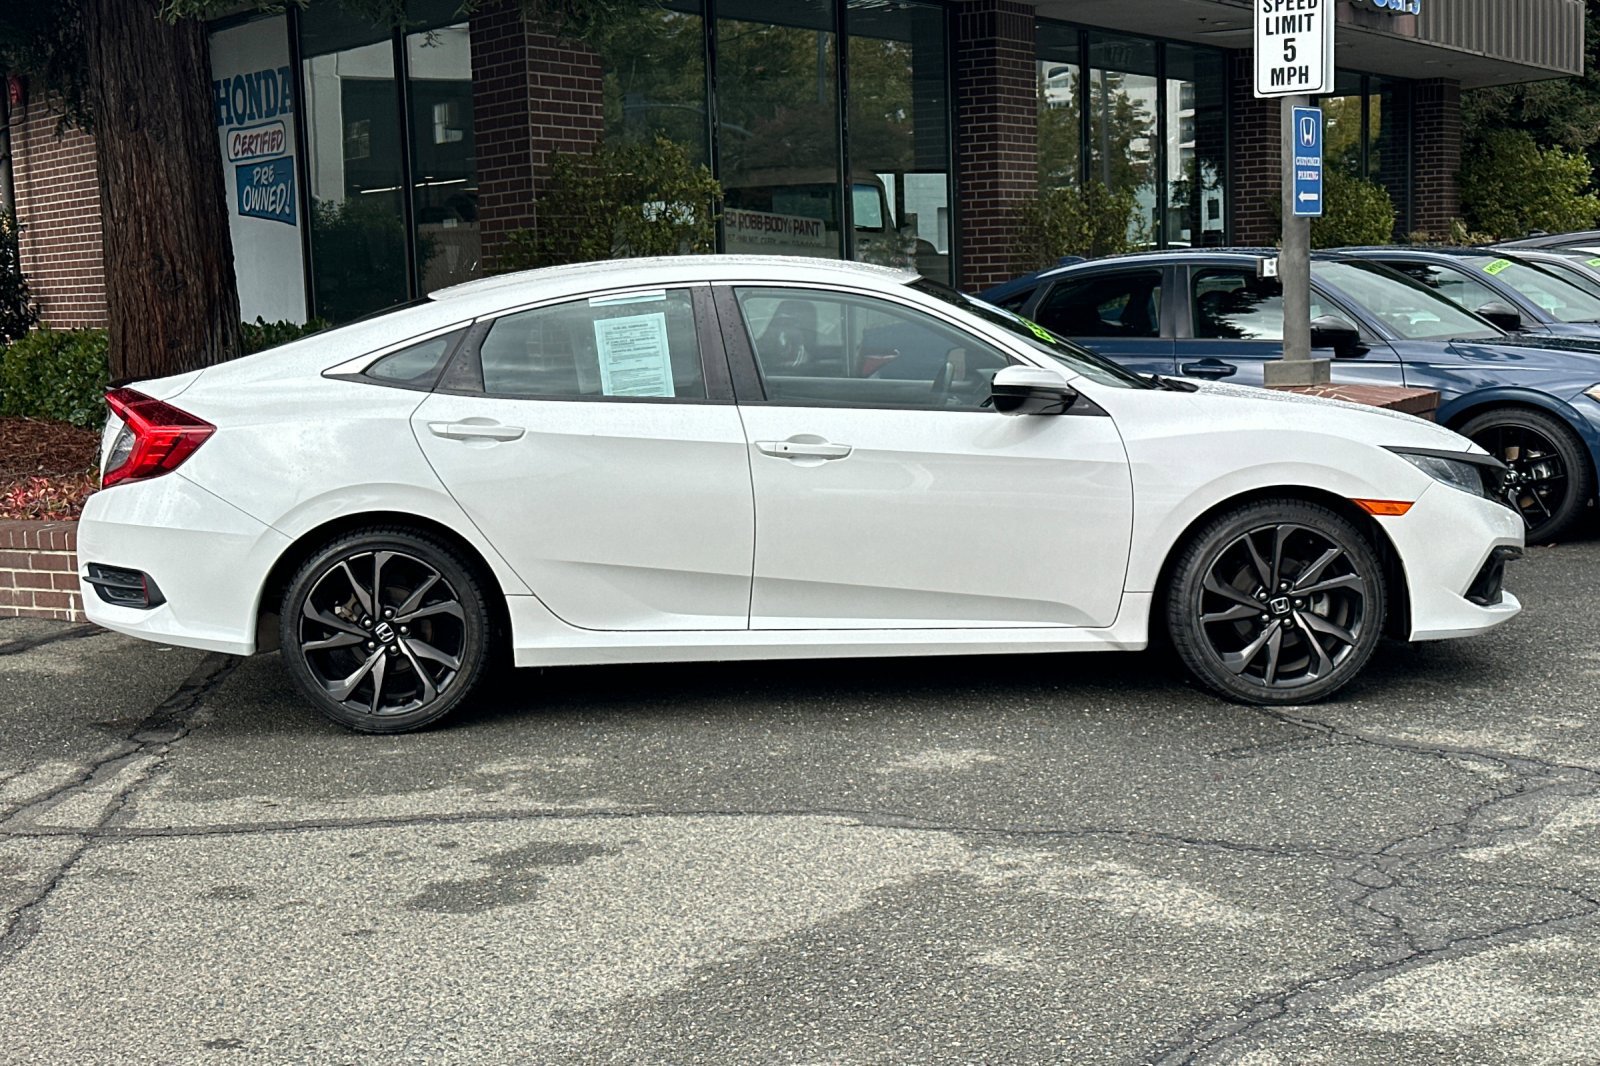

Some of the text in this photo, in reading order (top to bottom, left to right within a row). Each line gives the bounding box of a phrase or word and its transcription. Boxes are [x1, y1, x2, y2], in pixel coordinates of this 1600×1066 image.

[1263, 0, 1318, 13] SPEED
[1266, 13, 1315, 36] LIMIT
[1283, 38, 1297, 63] 5
[1270, 65, 1309, 87] MPH
[213, 66, 294, 126] HONDA
[233, 129, 283, 157] CERTIFIED
[243, 180, 291, 215] OWNED!
[793, 219, 821, 238] PAINT
